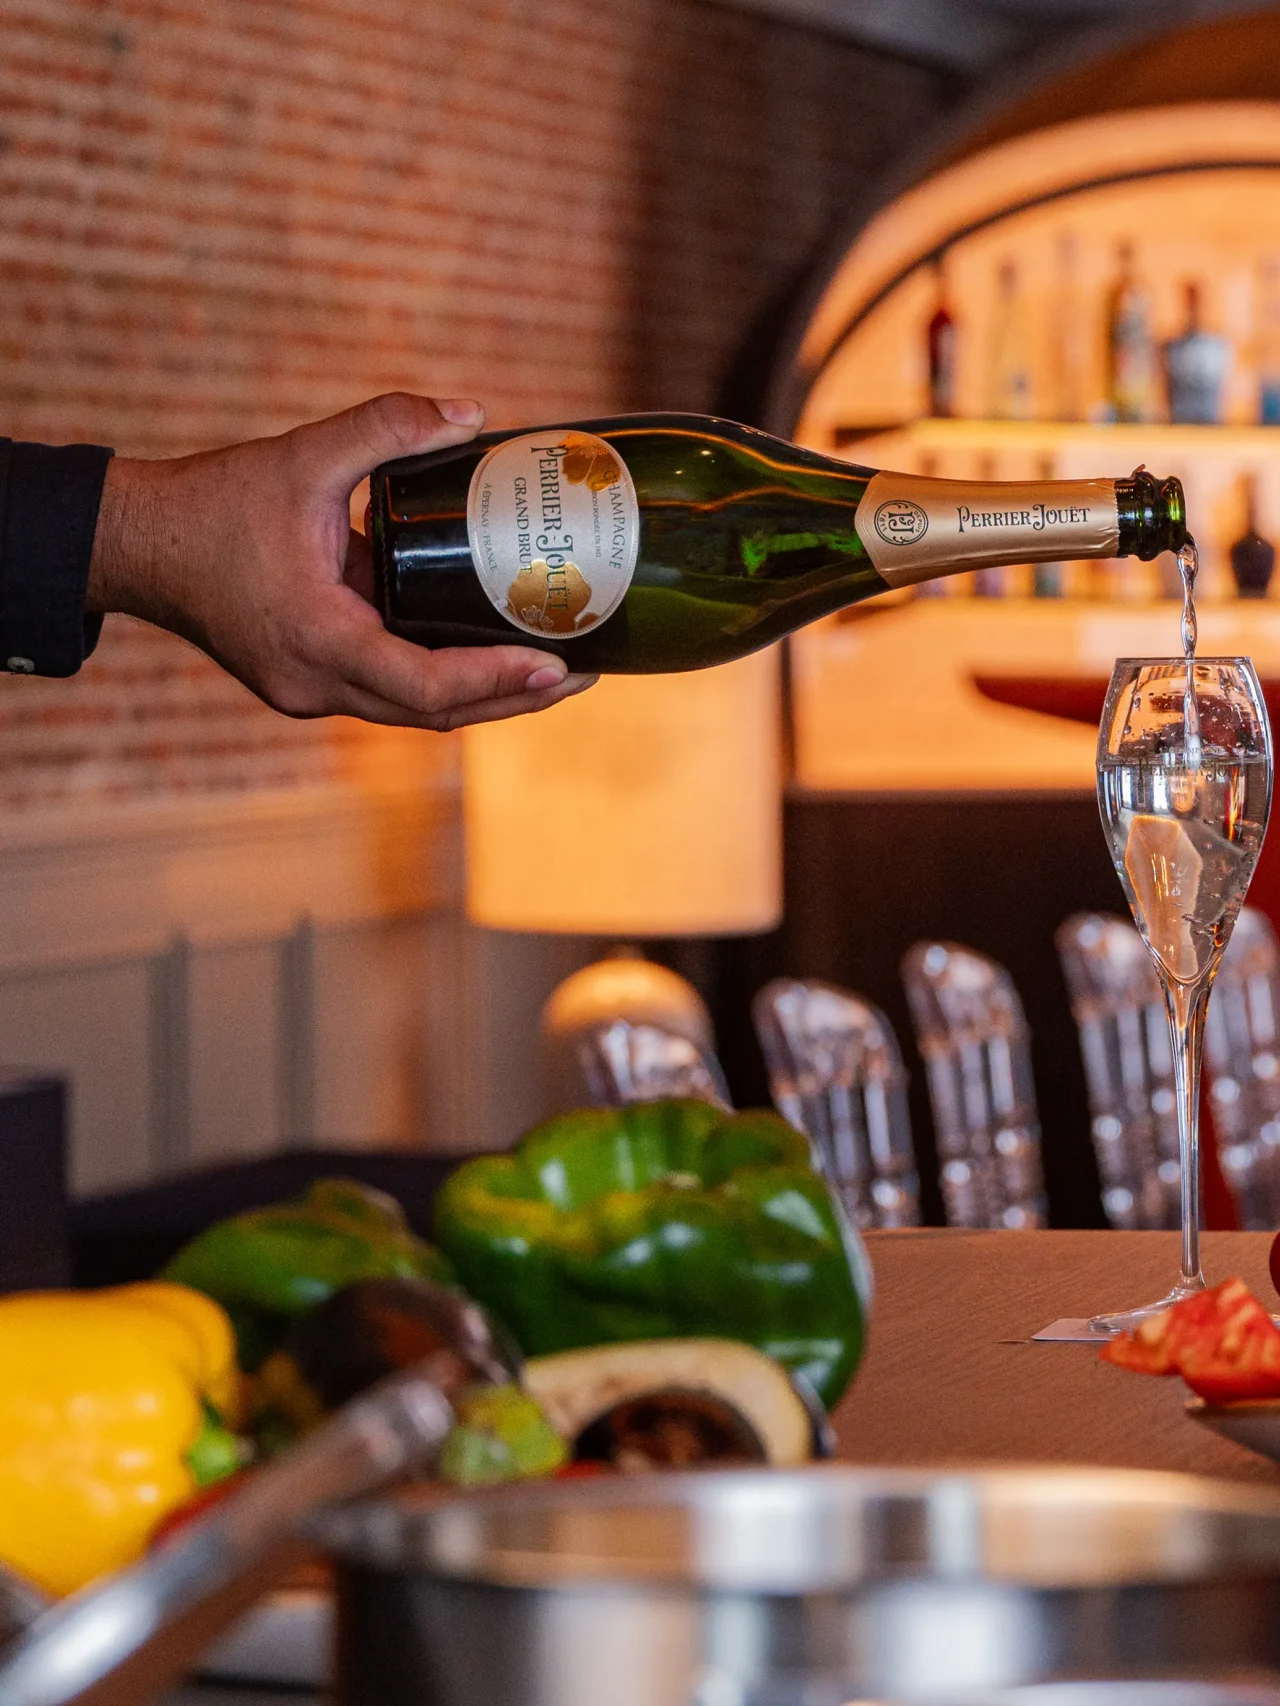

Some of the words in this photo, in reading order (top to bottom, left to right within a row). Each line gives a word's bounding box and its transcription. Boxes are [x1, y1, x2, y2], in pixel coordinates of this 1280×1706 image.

[481, 490, 491, 528] ÉPERNAY
[514, 476, 530, 531] GRAND
[603, 469, 626, 569] CHAMPAGNE
[913, 510, 923, 534] DEPUIS
[957, 504, 1091, 533] PERRIER-JOUËT
[879, 513, 888, 532] 1811
[483, 535, 499, 572] FRANCE
[517, 533, 533, 575] BRUT
